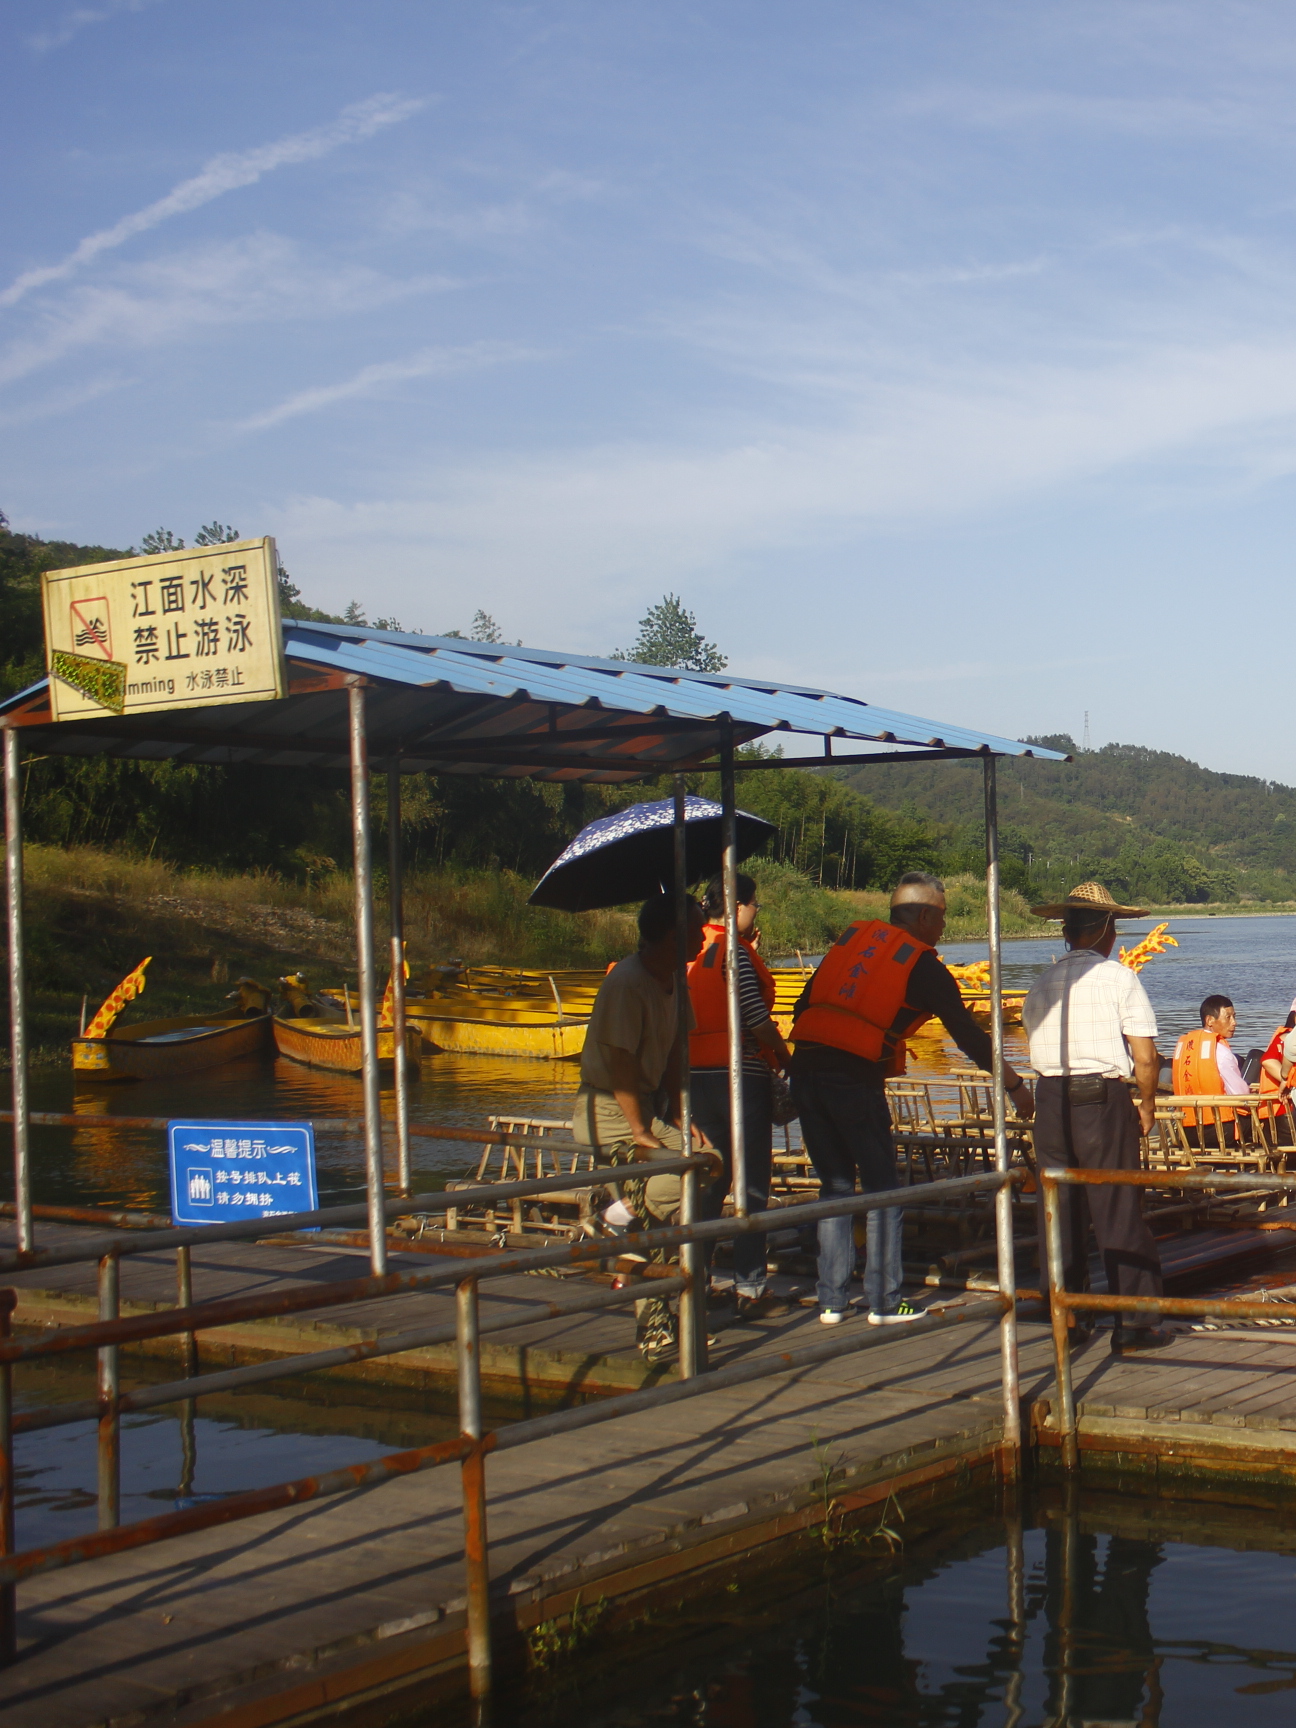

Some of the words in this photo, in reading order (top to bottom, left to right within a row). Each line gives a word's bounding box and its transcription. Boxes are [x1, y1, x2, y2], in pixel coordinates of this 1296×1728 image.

[130, 564, 250, 618] 江面水深
[133, 613, 254, 665] 禁止游泳
[186, 666, 244, 691] 水泳禁止
[210, 1139, 267, 1159] 温馨提示
[215, 1170, 302, 1186] 按号排队上筏
[216, 1192, 273, 1206] 请勿拥挤
